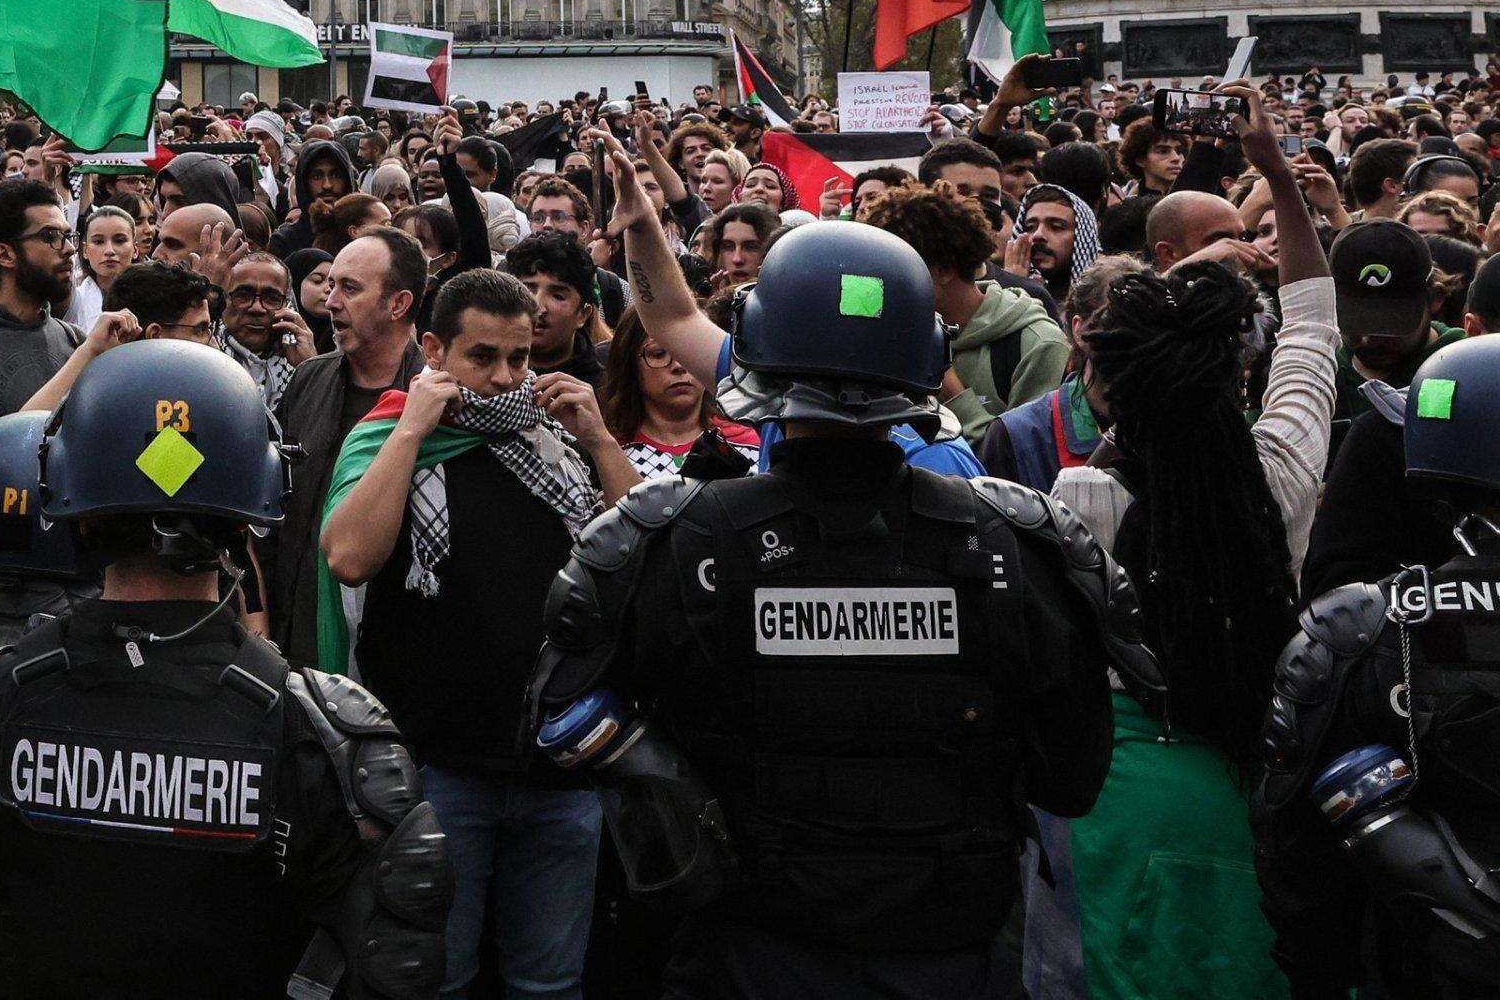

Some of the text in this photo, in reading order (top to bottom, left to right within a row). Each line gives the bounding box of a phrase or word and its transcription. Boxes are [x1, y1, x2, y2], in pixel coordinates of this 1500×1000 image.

[672, 21, 693, 33] WALL
[847, 107, 870, 119] STOP
[847, 119, 868, 130] STOP
[155, 399, 191, 432] P3
[3, 486, 29, 515] P1
[1402, 581, 1500, 612] GEN
[759, 600, 955, 641] GENDARMERIE
[11, 738, 262, 826] GENDARMERIE
